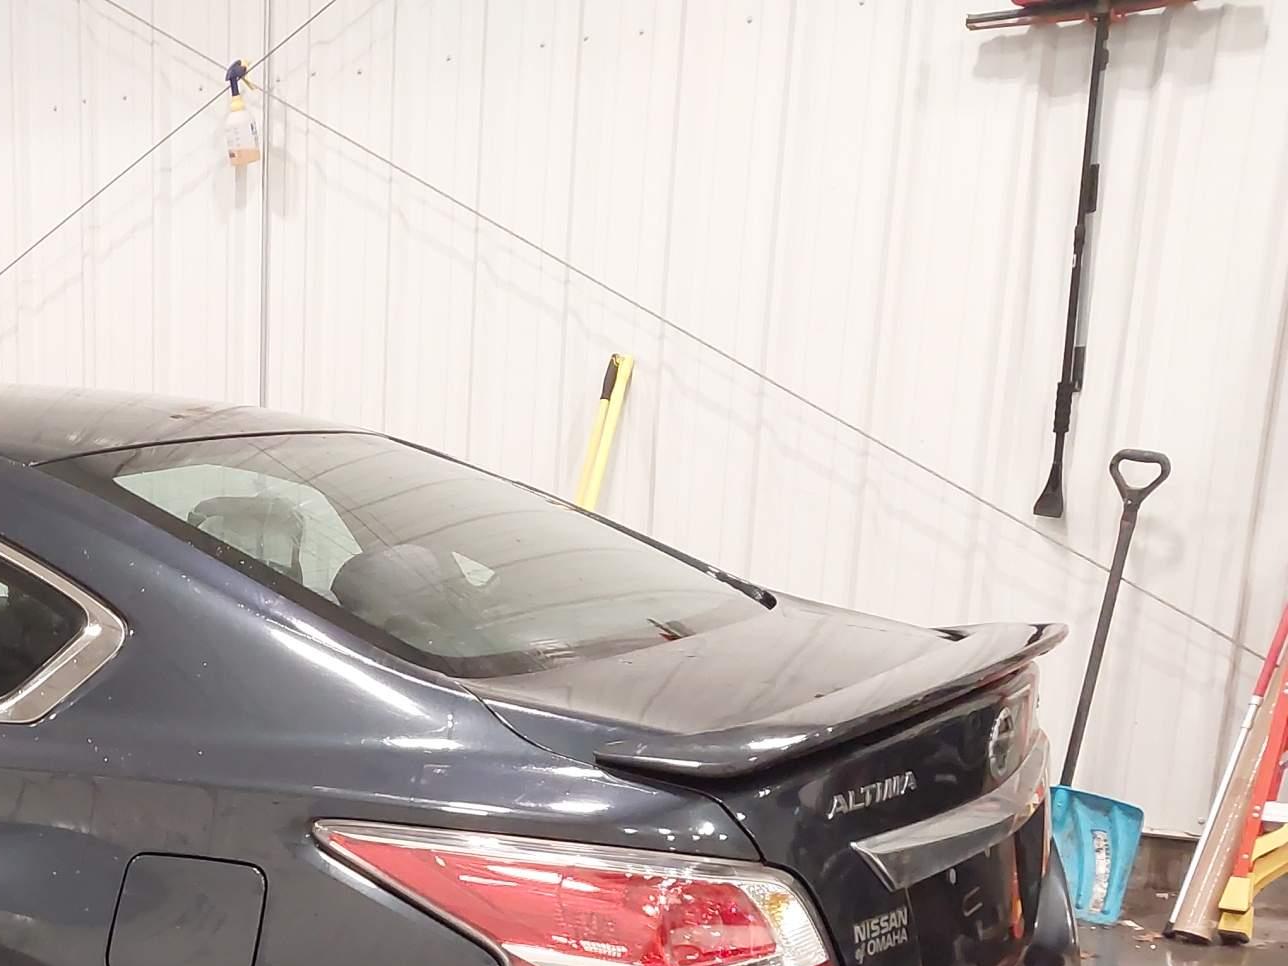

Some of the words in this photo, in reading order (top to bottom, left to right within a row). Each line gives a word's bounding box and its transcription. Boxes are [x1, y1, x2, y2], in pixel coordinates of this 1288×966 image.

[827, 771, 917, 820] ALTIMA
[853, 906, 908, 944] NISSAN
[866, 929, 908, 956] OMAHA
